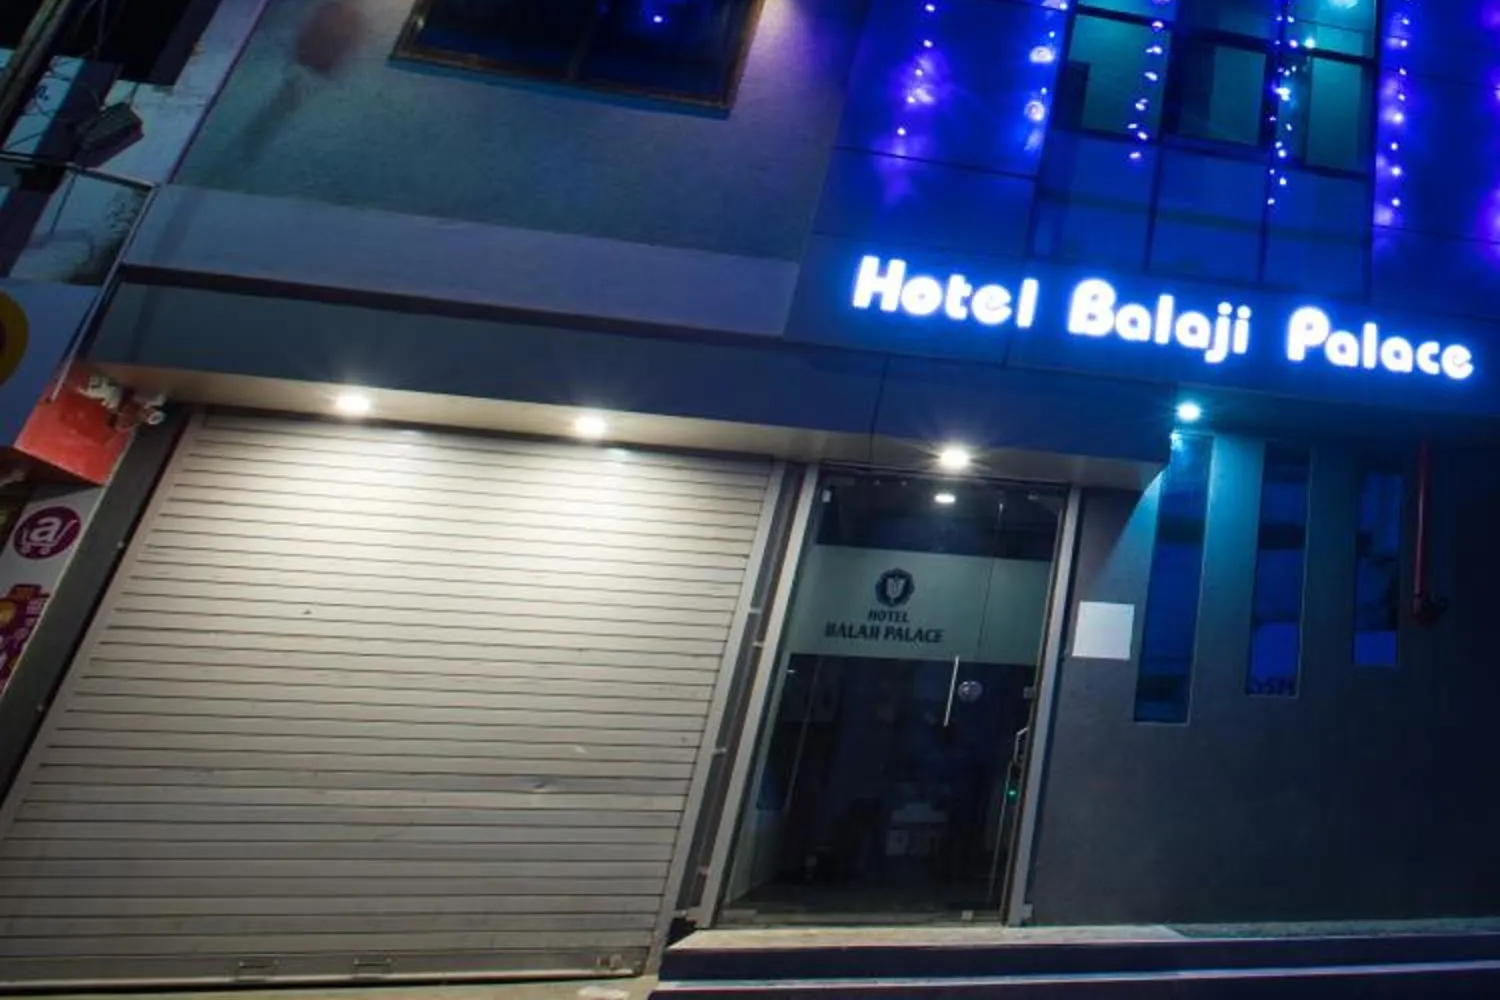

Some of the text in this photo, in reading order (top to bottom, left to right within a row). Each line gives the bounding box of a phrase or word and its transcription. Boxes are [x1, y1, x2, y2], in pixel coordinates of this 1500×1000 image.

[852, 254, 1475, 380] Hotel Balaji Palace
[867, 608, 909, 623] HOTEL
[883, 625, 946, 643] PALACE
